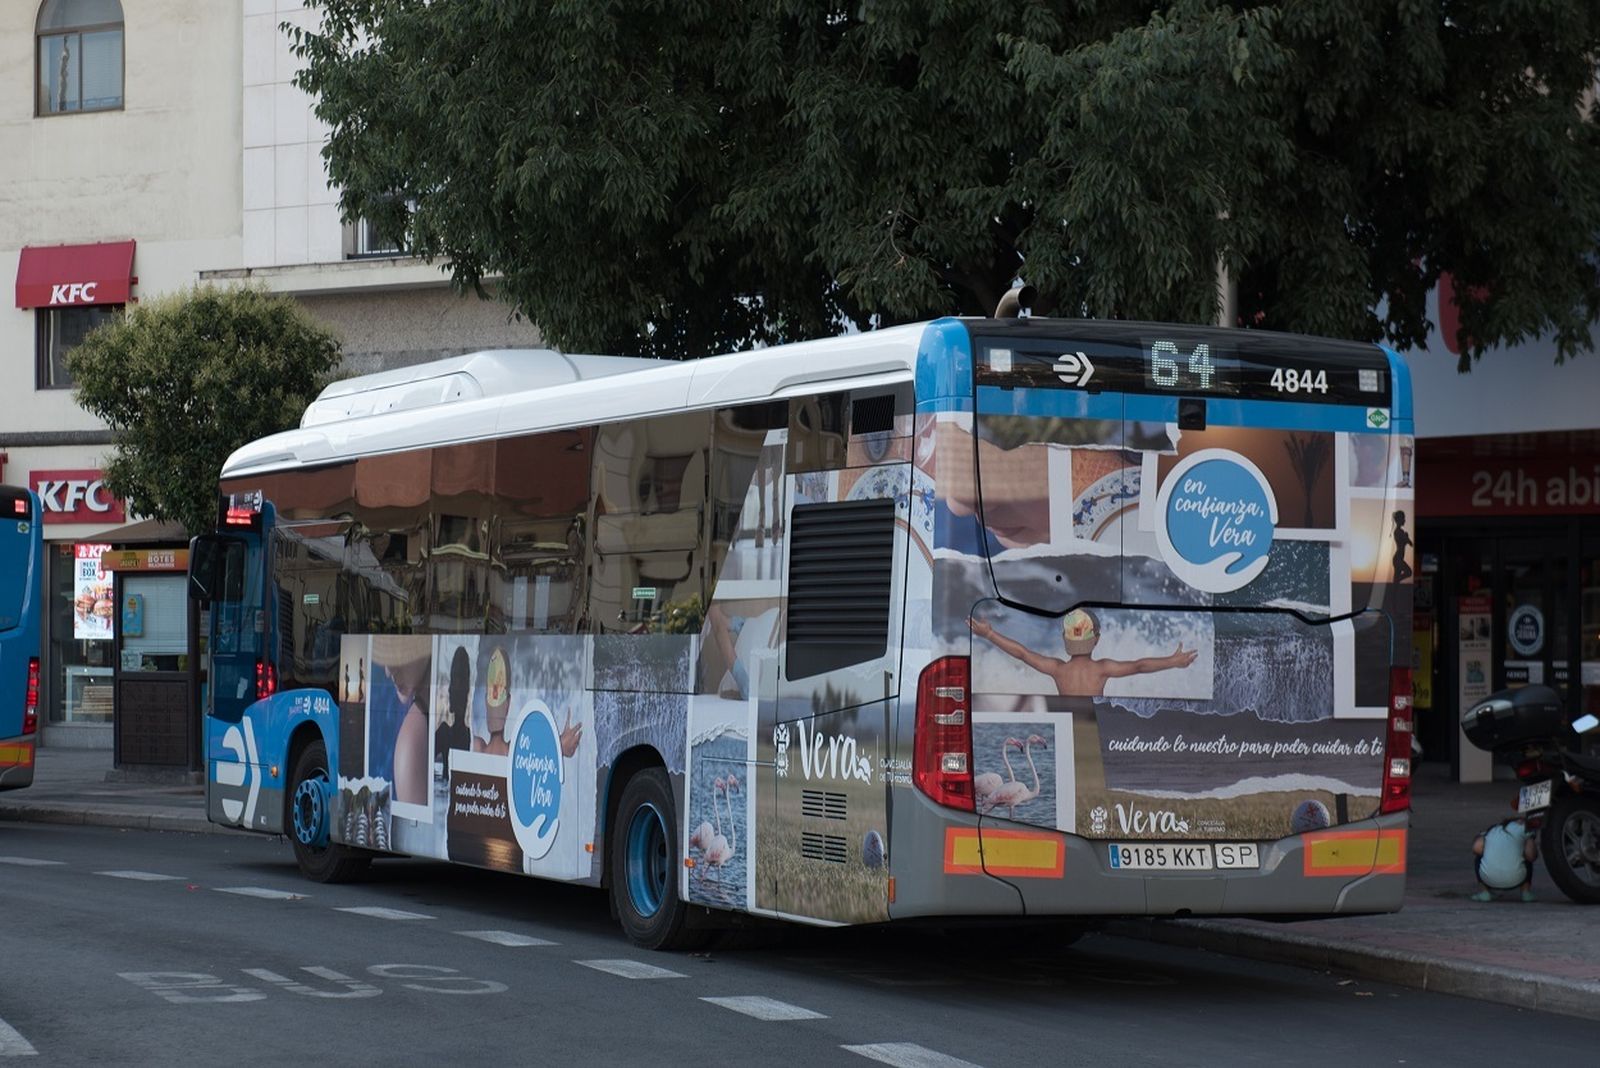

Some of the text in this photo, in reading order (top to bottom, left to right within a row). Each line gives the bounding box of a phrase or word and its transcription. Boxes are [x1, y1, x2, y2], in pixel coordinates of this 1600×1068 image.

[50, 282, 98, 304] KFC
[1151, 341, 1215, 389] 64
[1270, 368, 1328, 393] 4844
[37, 480, 109, 512] KFC
[1184, 479, 1207, 495] en
[1471, 465, 1600, 507] 24h abi
[1175, 496, 1264, 525] confianza,
[1209, 516, 1256, 547] Vera
[520, 733, 531, 750] en
[797, 712, 857, 780] Vera
[1108, 734, 1384, 758] cuidando lo nuestro para poder cuidar de ti
[530, 774, 553, 808] Vera
[1115, 801, 1178, 835] Vera
[1121, 846, 1252, 866] 9185 KKT SP
[116, 964, 509, 1002] BUS
